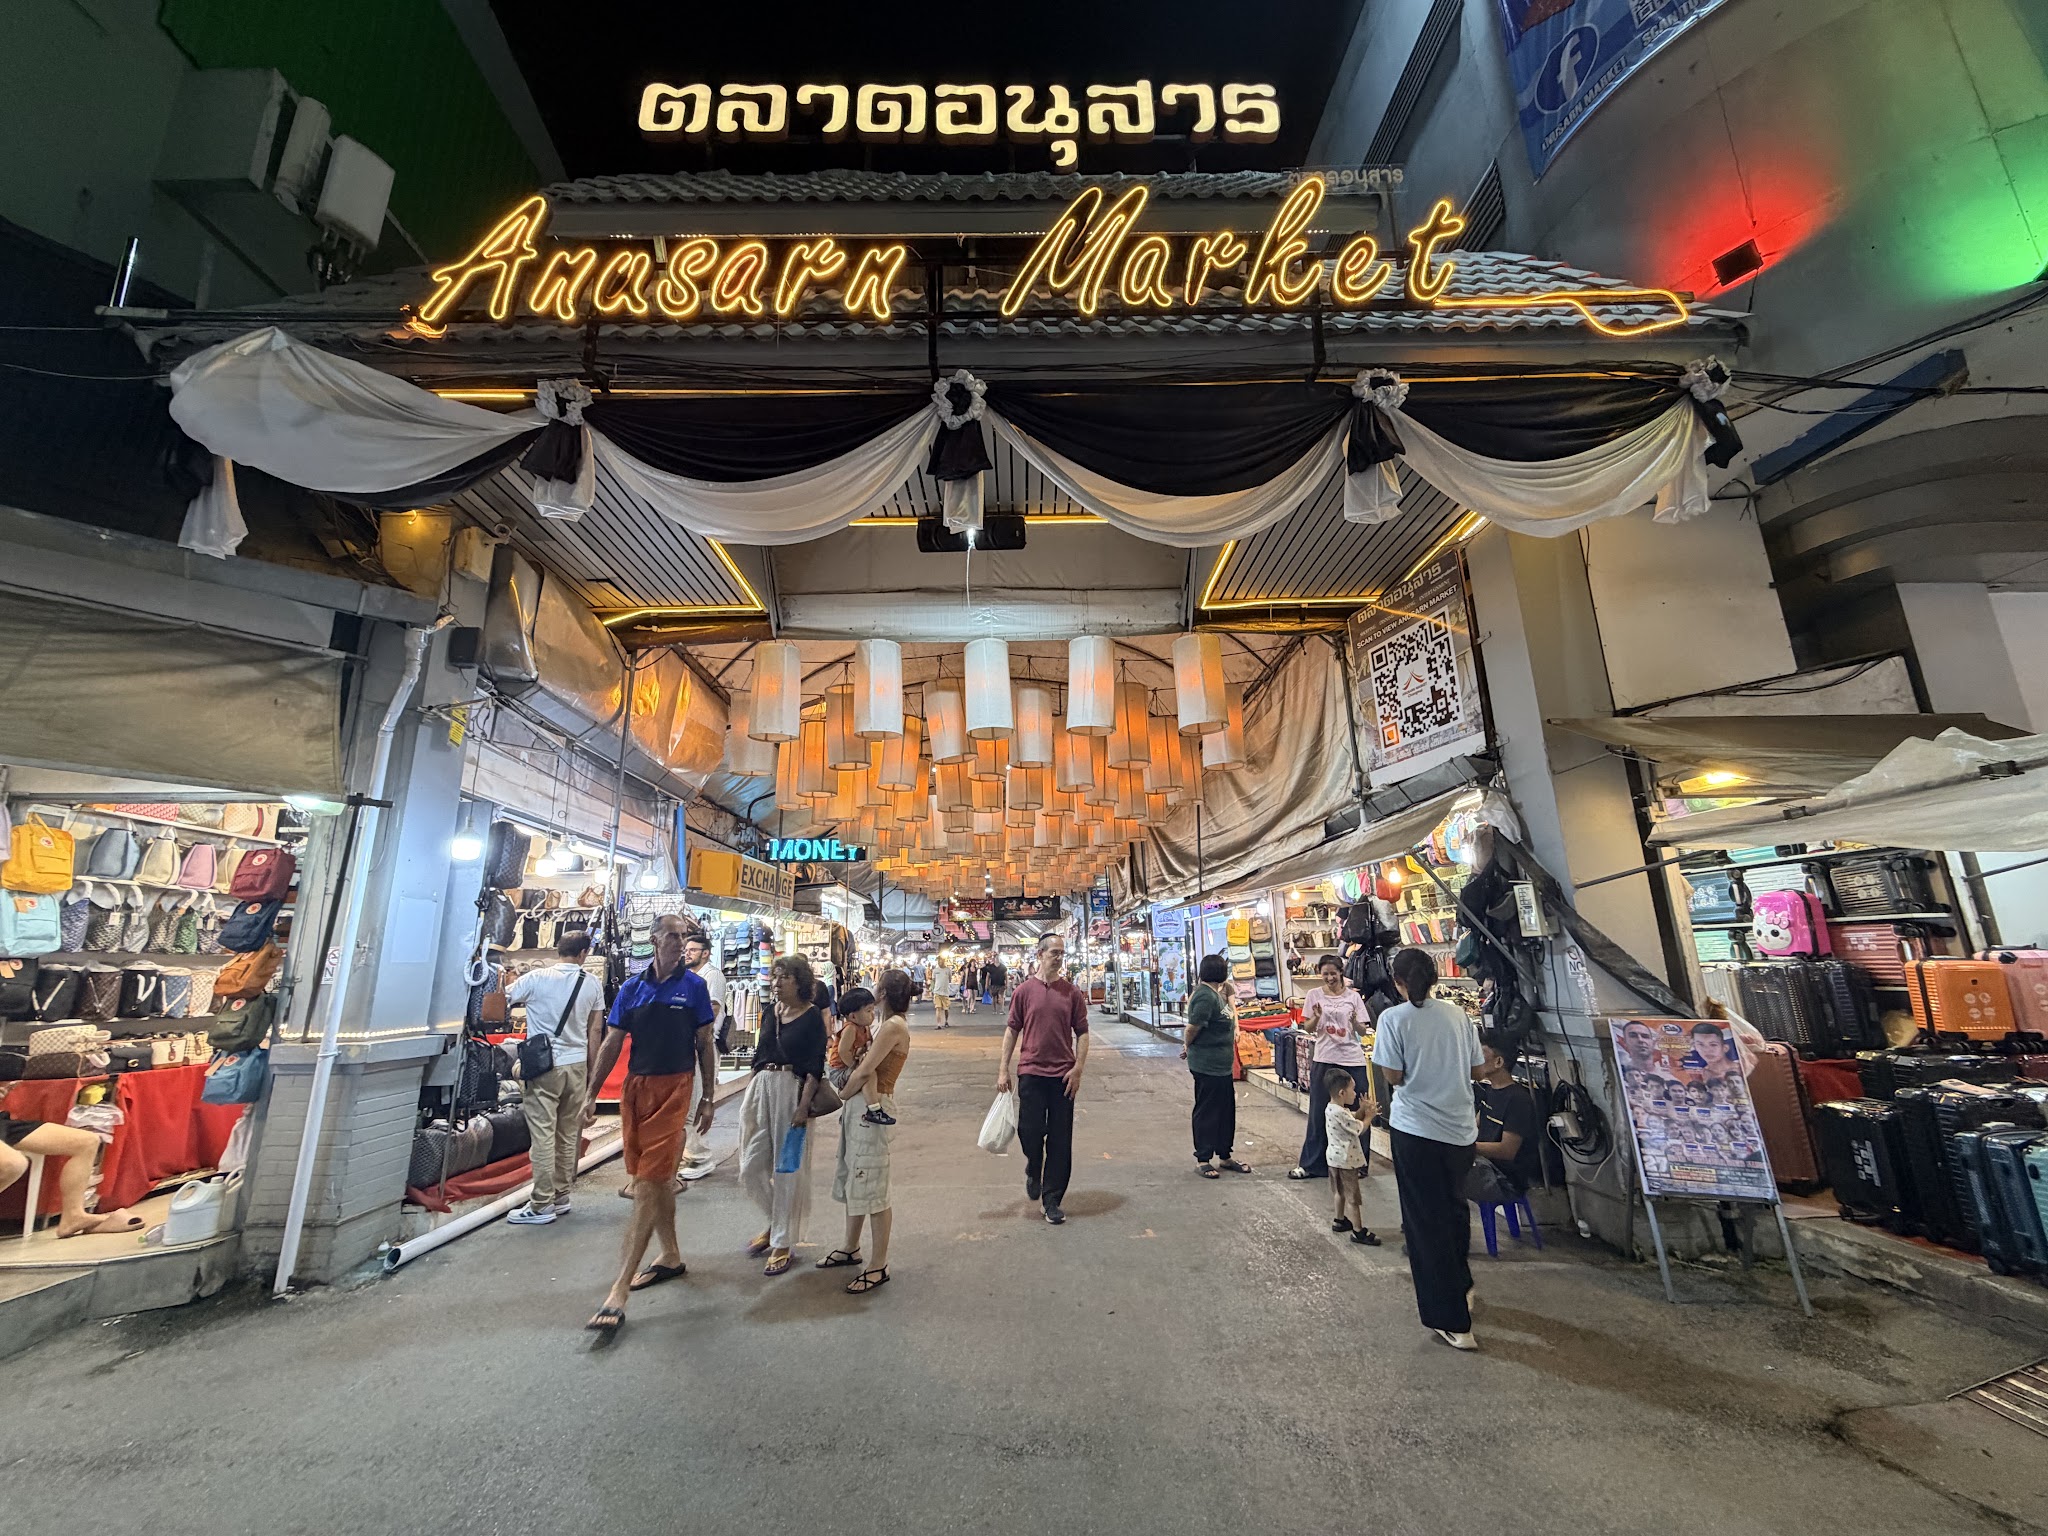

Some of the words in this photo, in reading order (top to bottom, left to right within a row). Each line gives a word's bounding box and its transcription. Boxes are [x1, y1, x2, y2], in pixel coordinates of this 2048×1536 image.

[1641, 12, 1679, 48] SCAN
[1583, 54, 1629, 106] MARKET
[638, 79, 1281, 168] ตลาดอนุสาร
[420, 195, 906, 321] Anusarn
[1001, 176, 1464, 315] Market
[1356, 636, 1374, 650] SCAN
[1373, 629, 1383, 641] TO
[1381, 621, 1398, 636] VIEW
[1429, 583, 1459, 610] MARKET
[1642, 1154, 1668, 1173] 27
